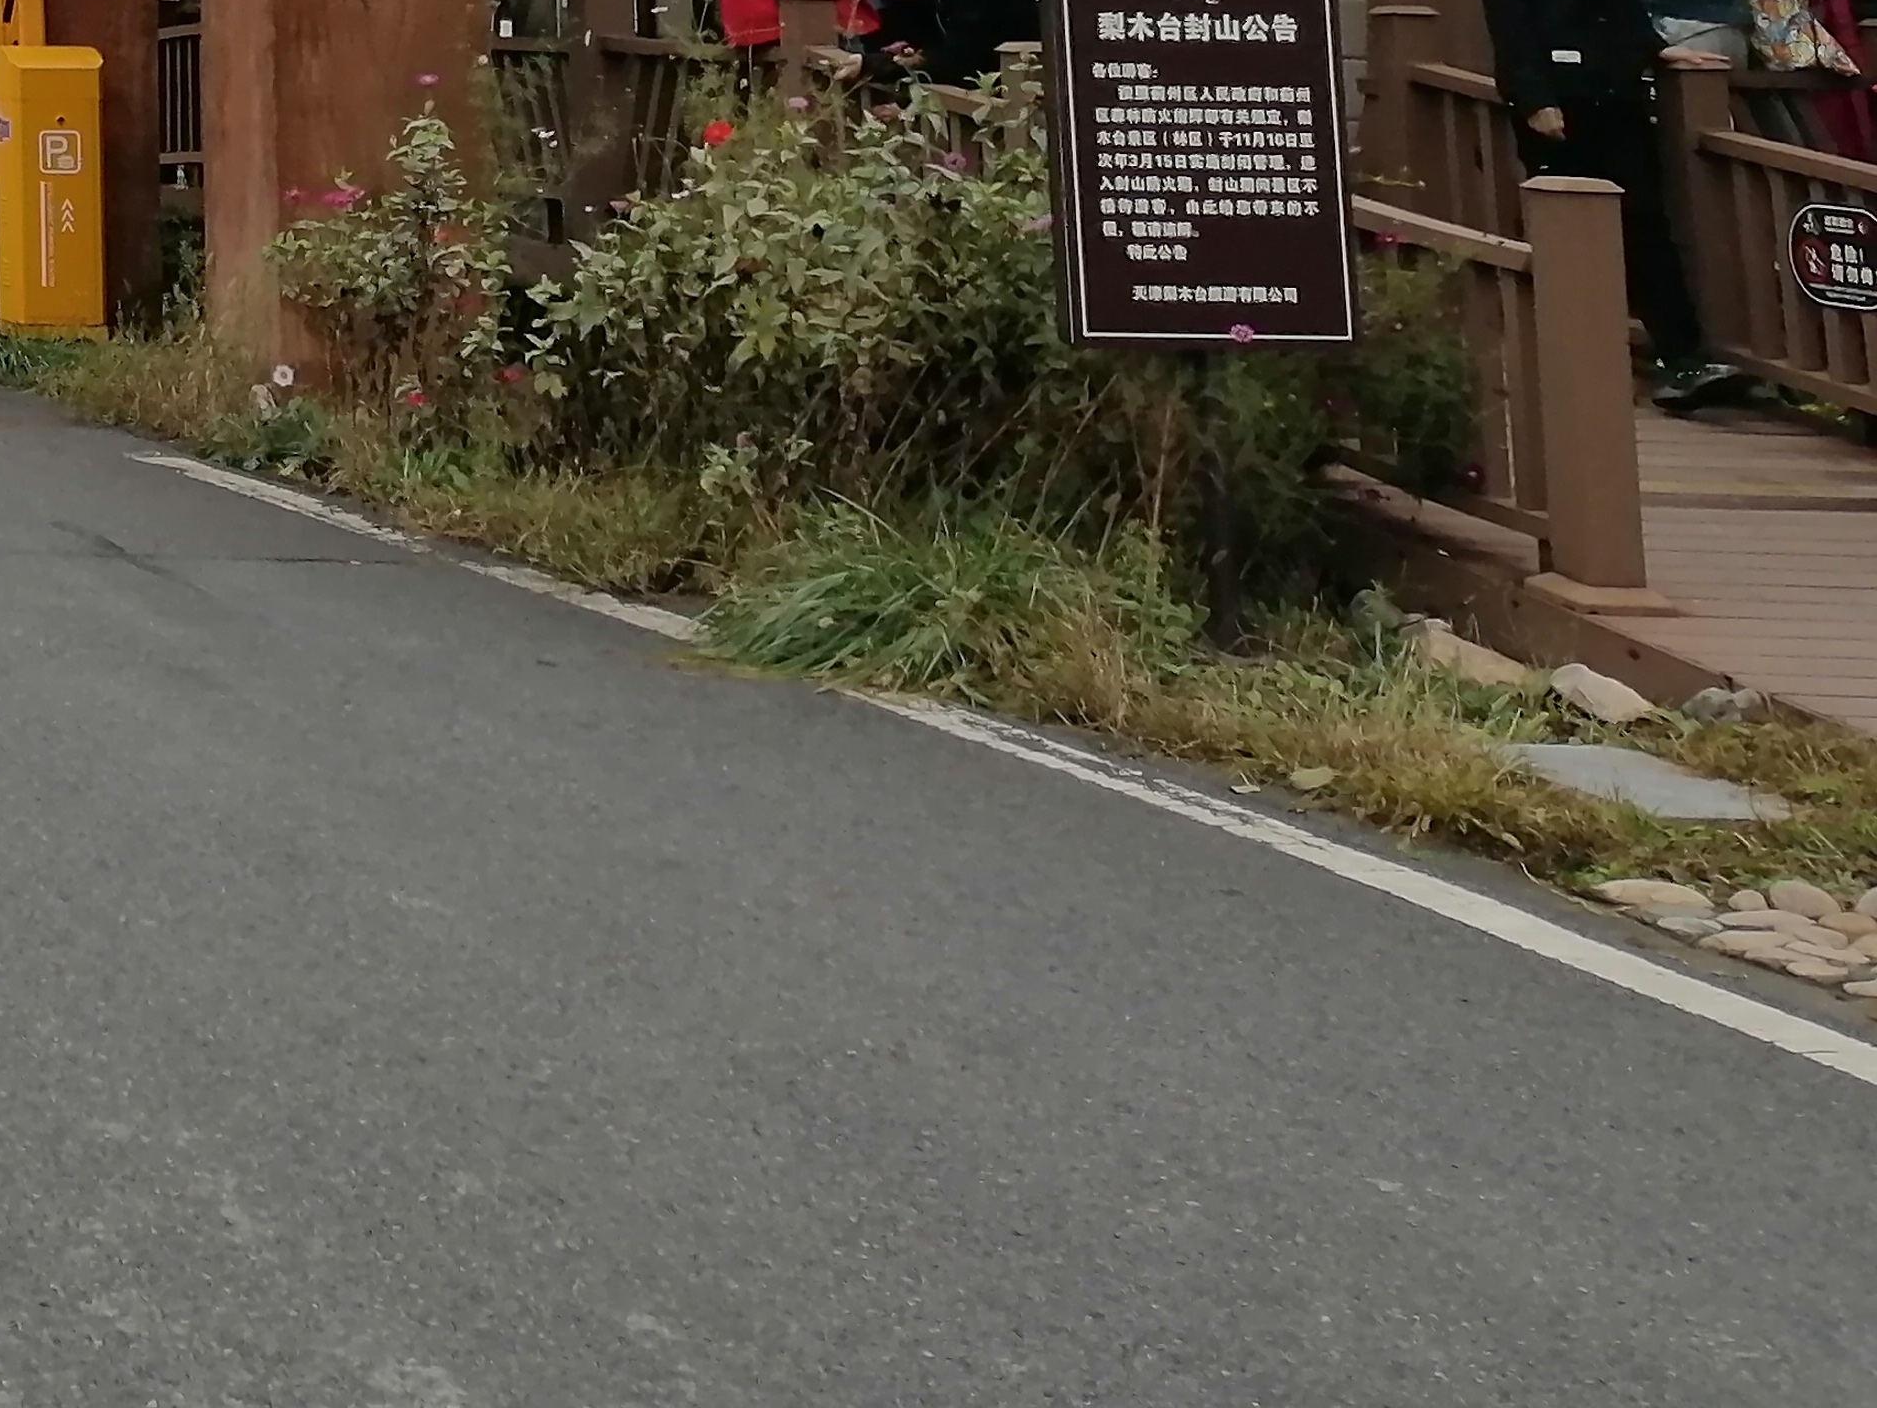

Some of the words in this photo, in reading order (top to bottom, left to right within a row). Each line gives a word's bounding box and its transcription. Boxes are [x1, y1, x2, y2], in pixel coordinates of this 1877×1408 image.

[1097, 11, 1298, 43] 梨木台封山公告
